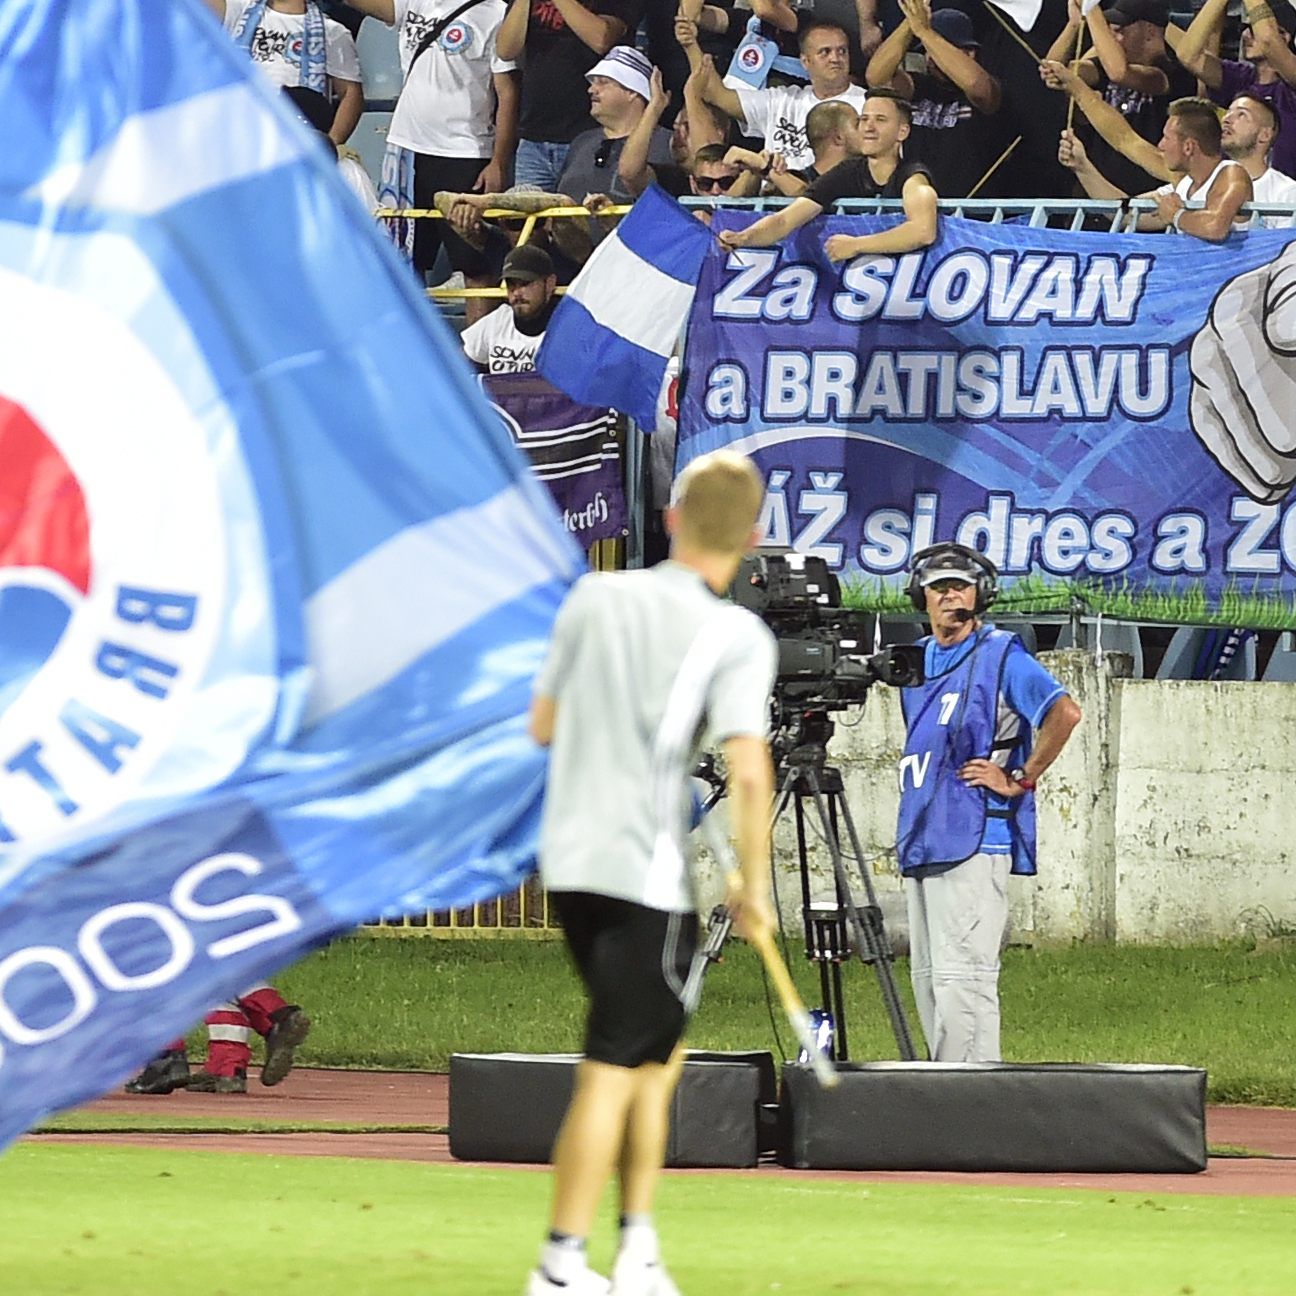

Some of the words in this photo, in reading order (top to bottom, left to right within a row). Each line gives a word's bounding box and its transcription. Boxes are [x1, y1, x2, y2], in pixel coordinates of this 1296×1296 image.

[712, 249, 817, 320] Za
[834, 253, 1151, 322] SLOVAN
[706, 363, 747, 418] a
[765, 350, 1172, 419] BRATISLAVU
[757, 470, 845, 568] ÁŽ
[864, 493, 938, 571] si
[957, 495, 1135, 572] dres
[1153, 512, 1205, 572] a
[1226, 496, 1296, 573] Z
[899, 751, 932, 792] TV
